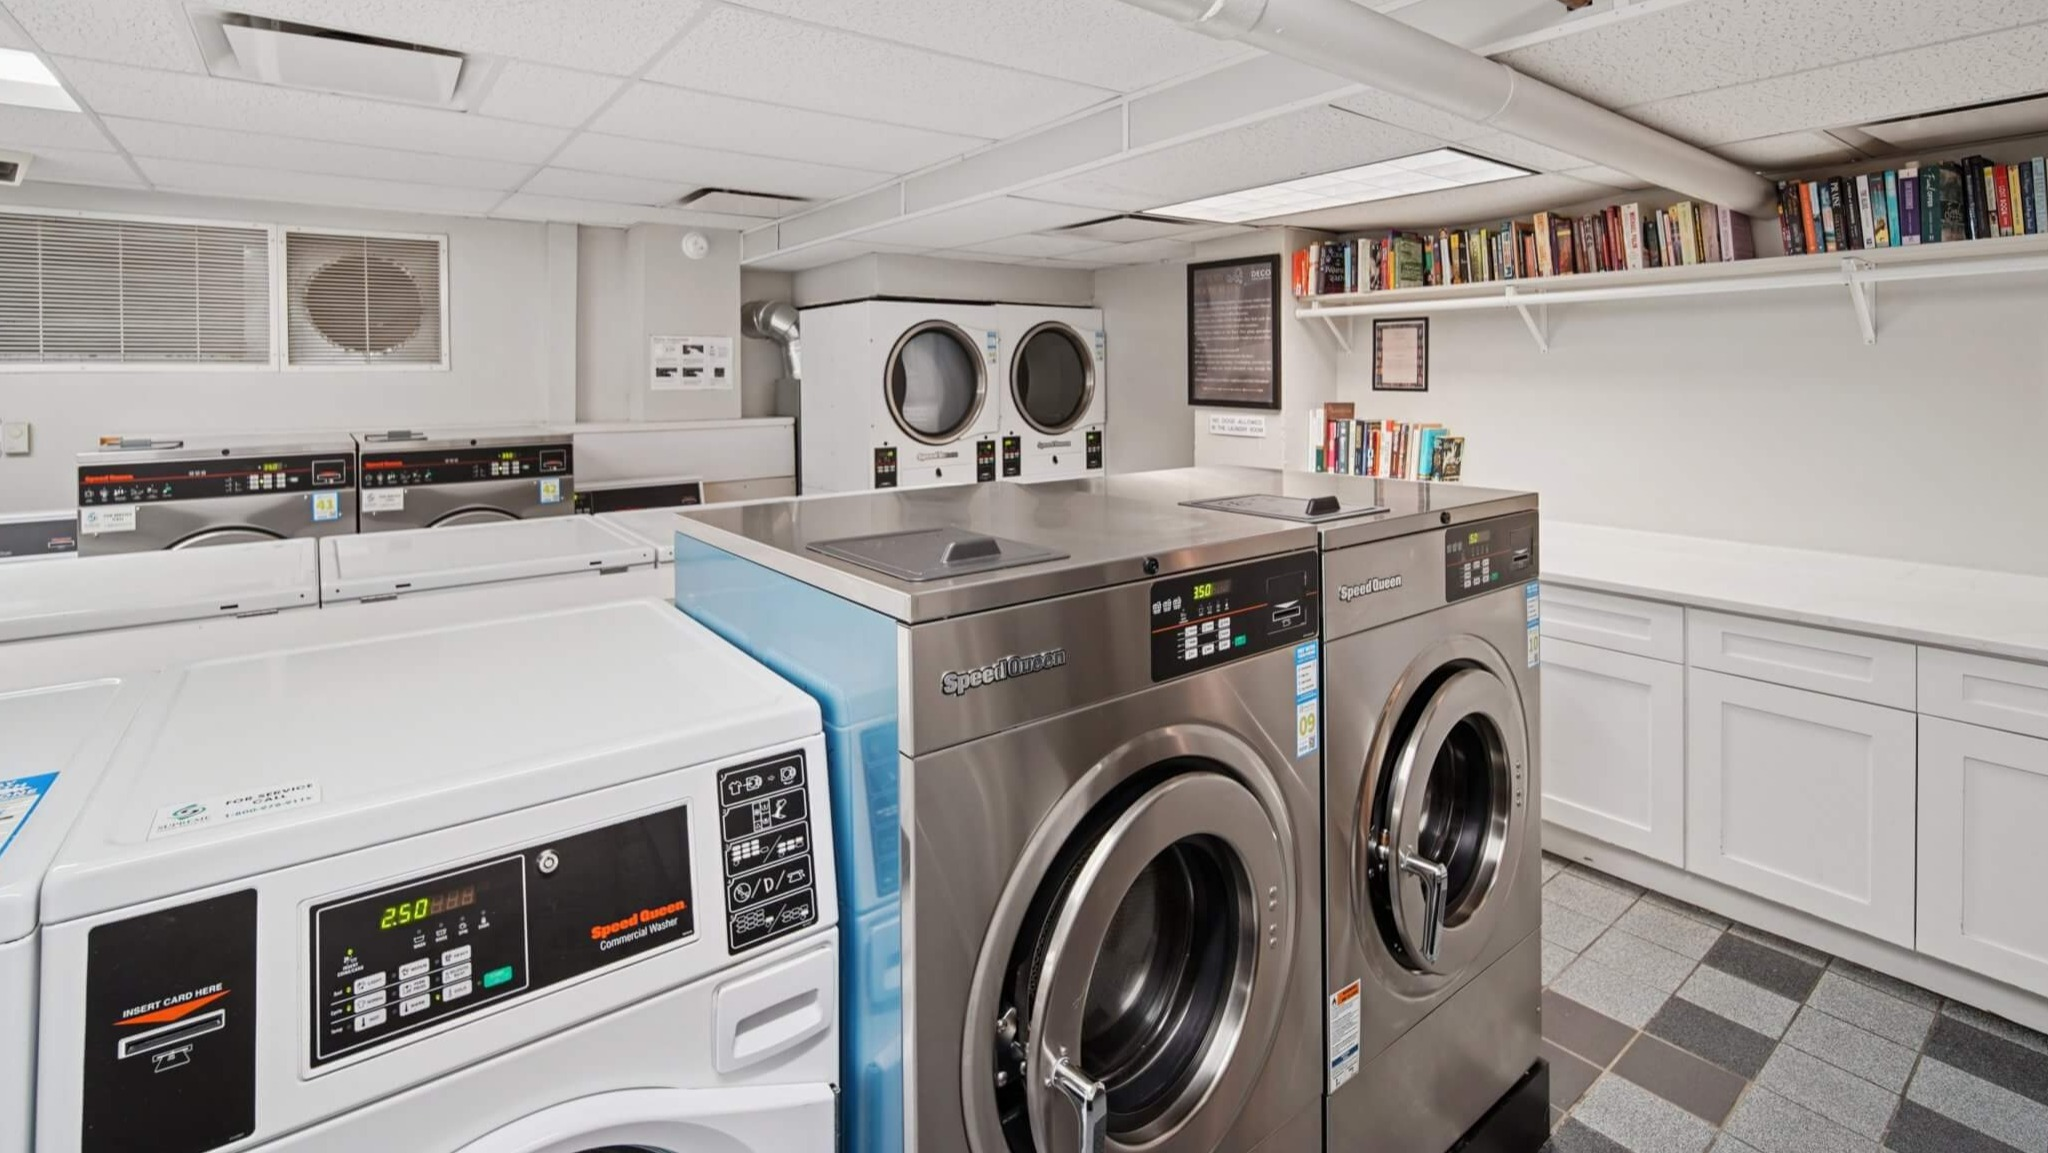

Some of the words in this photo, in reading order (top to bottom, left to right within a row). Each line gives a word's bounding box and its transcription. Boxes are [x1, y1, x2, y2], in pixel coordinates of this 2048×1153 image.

[1339, 577, 1372, 603] Speed
[1371, 574, 1402, 592] Queen
[941, 658, 1008, 696] Speed
[1006, 648, 1067, 678] Queen
[1299, 712, 1316, 736] 09
[381, 898, 428, 930] 2.50
[591, 913, 639, 939] Speed
[639, 900, 686, 922] Queen
[600, 927, 648, 951] Commercial
[648, 917, 678, 934] Washer
[122, 1000, 161, 1018] INSERT
[163, 992, 193, 1007] CARD
[194, 982, 223, 999] HERE
